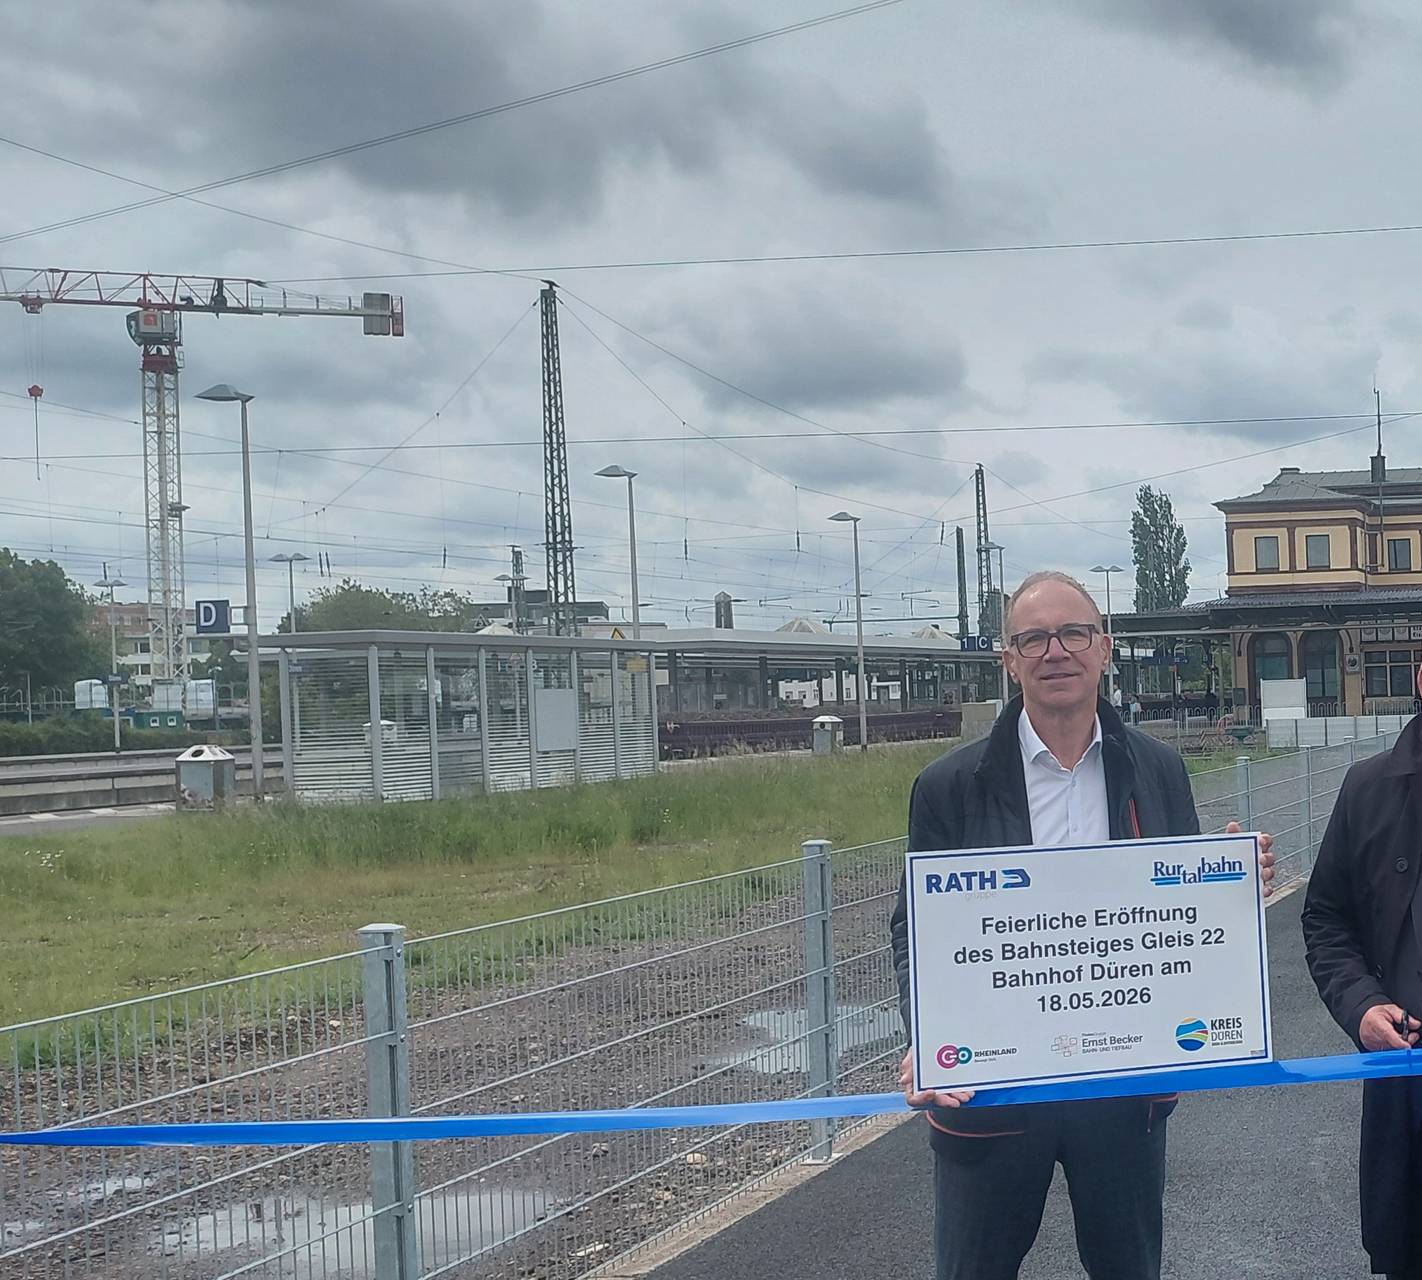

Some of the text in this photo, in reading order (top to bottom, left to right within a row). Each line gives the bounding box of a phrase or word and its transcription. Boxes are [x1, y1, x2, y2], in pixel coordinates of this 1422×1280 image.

[200, 603, 216, 626] D
[962, 636, 988, 649] 1 C
[1151, 855, 1246, 886] Rurtalbahn
[926, 871, 996, 893] RATH
[982, 907, 1196, 934] Feierliche Eröffnung
[954, 928, 1224, 964] des Bahnsteiges Gleis 22
[993, 961, 1191, 988] Bahnhof Düren am
[1038, 987, 1151, 1012] 18.05.2026
[1210, 1016, 1242, 1031] KREIS
[1081, 1036, 1108, 1046] Ernst
[1109, 1033, 1143, 1044] Becker
[1211, 1029, 1243, 1041] DÜREN
[974, 1047, 1017, 1057] RHEINLAND
